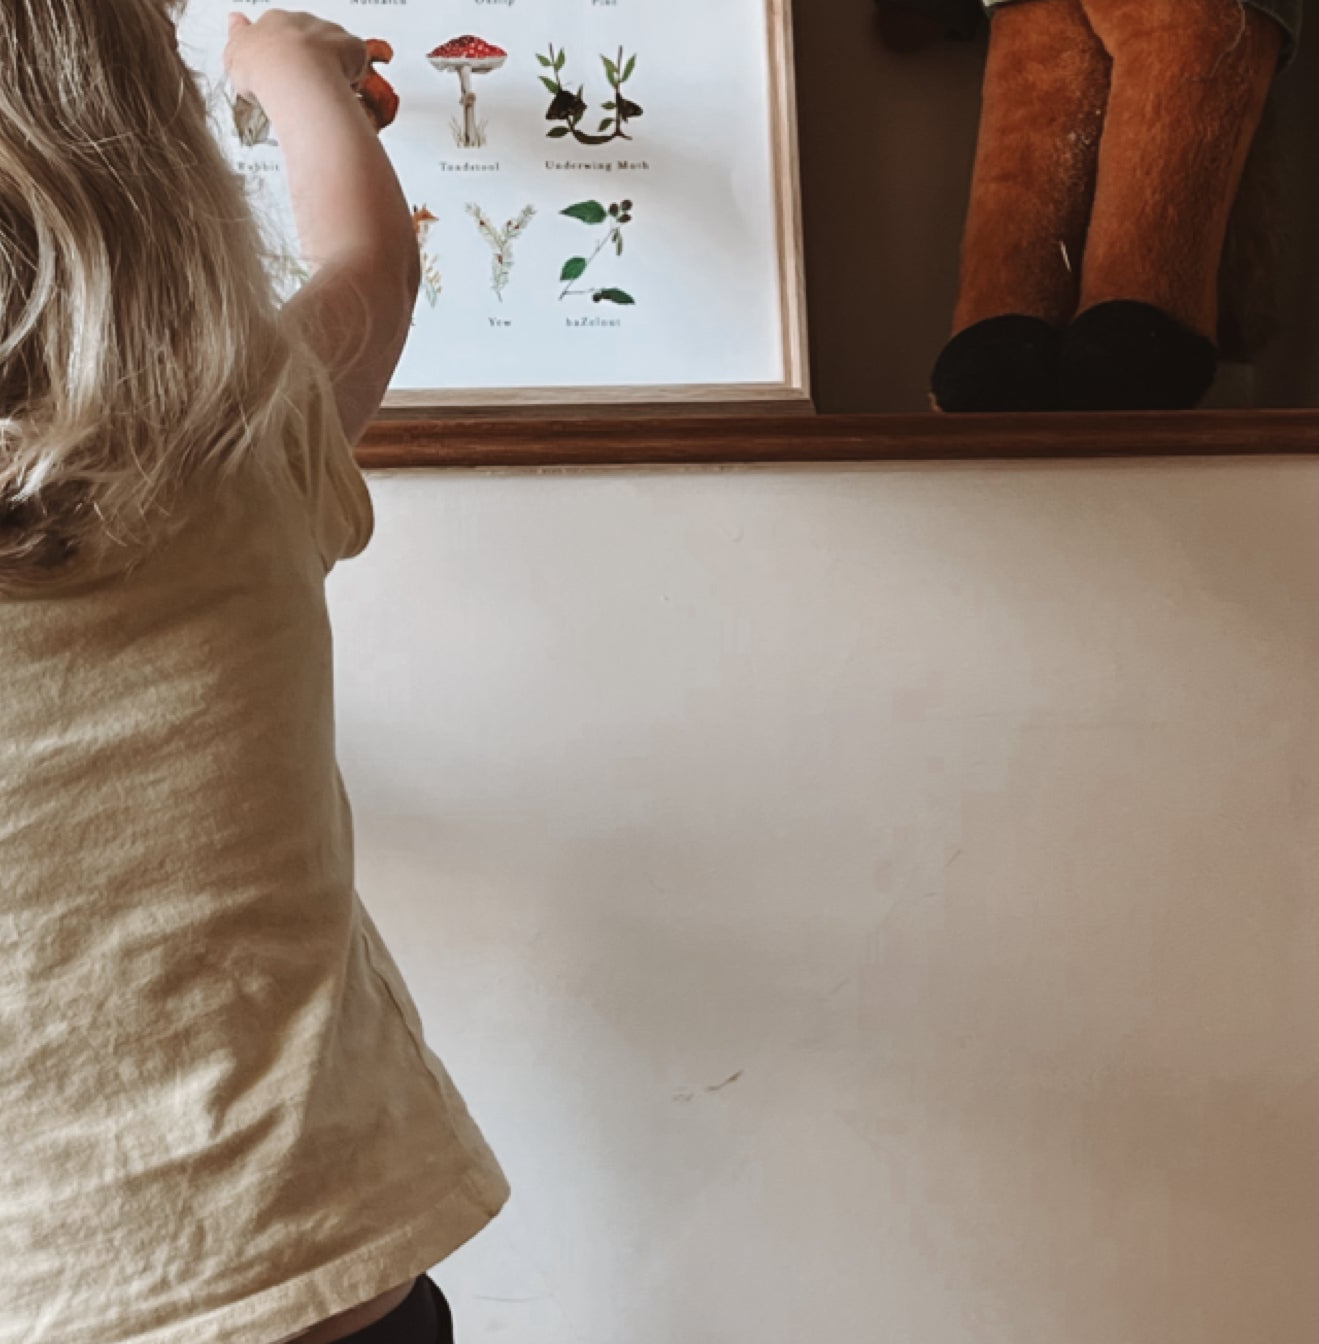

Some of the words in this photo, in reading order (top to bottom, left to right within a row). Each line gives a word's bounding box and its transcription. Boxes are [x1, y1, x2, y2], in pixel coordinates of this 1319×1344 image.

[545, 159, 613, 173] Underwing
[616, 159, 650, 171] Moth
[487, 316, 512, 328] Yew
